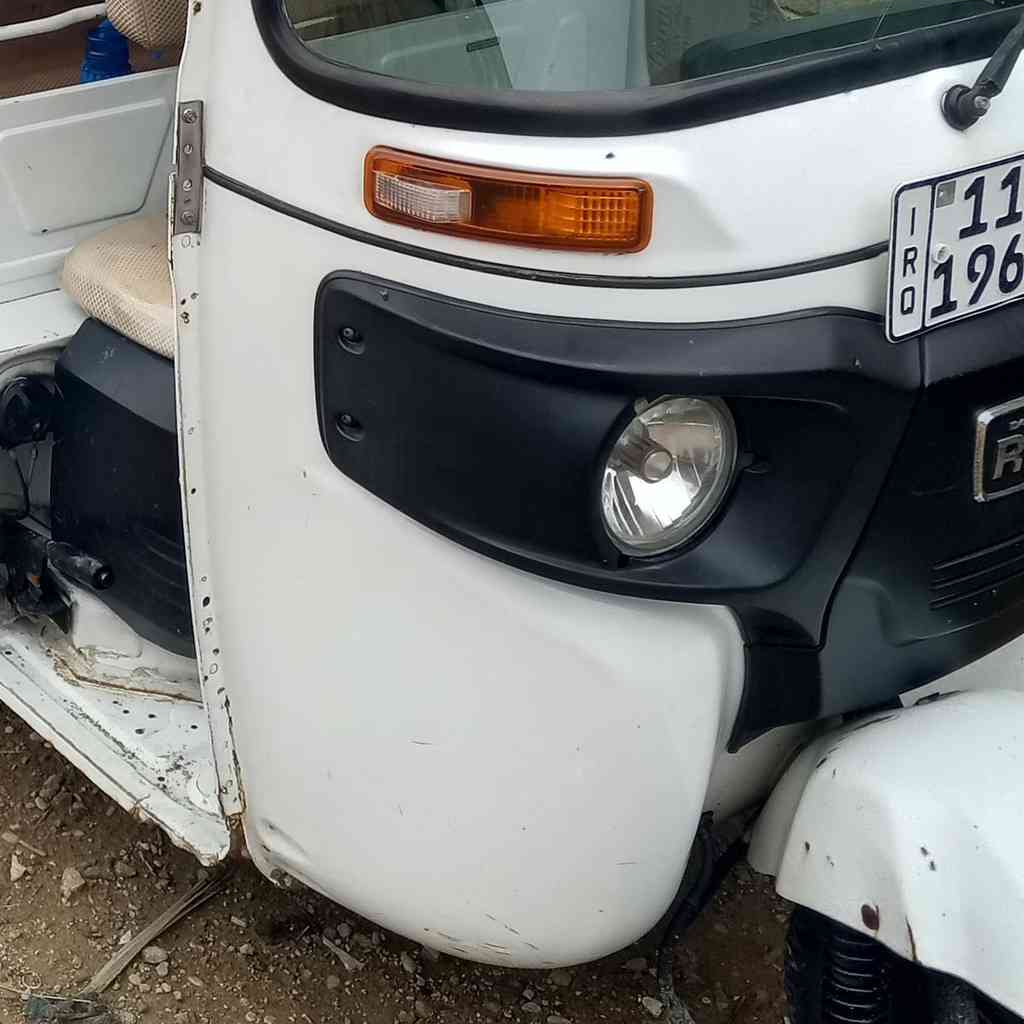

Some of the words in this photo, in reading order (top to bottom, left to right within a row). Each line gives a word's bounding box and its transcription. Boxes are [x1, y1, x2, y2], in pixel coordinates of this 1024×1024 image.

[959, 166, 1023, 240] 11
[900, 207, 918, 316] IRQ
[930, 233, 1024, 319] 196
